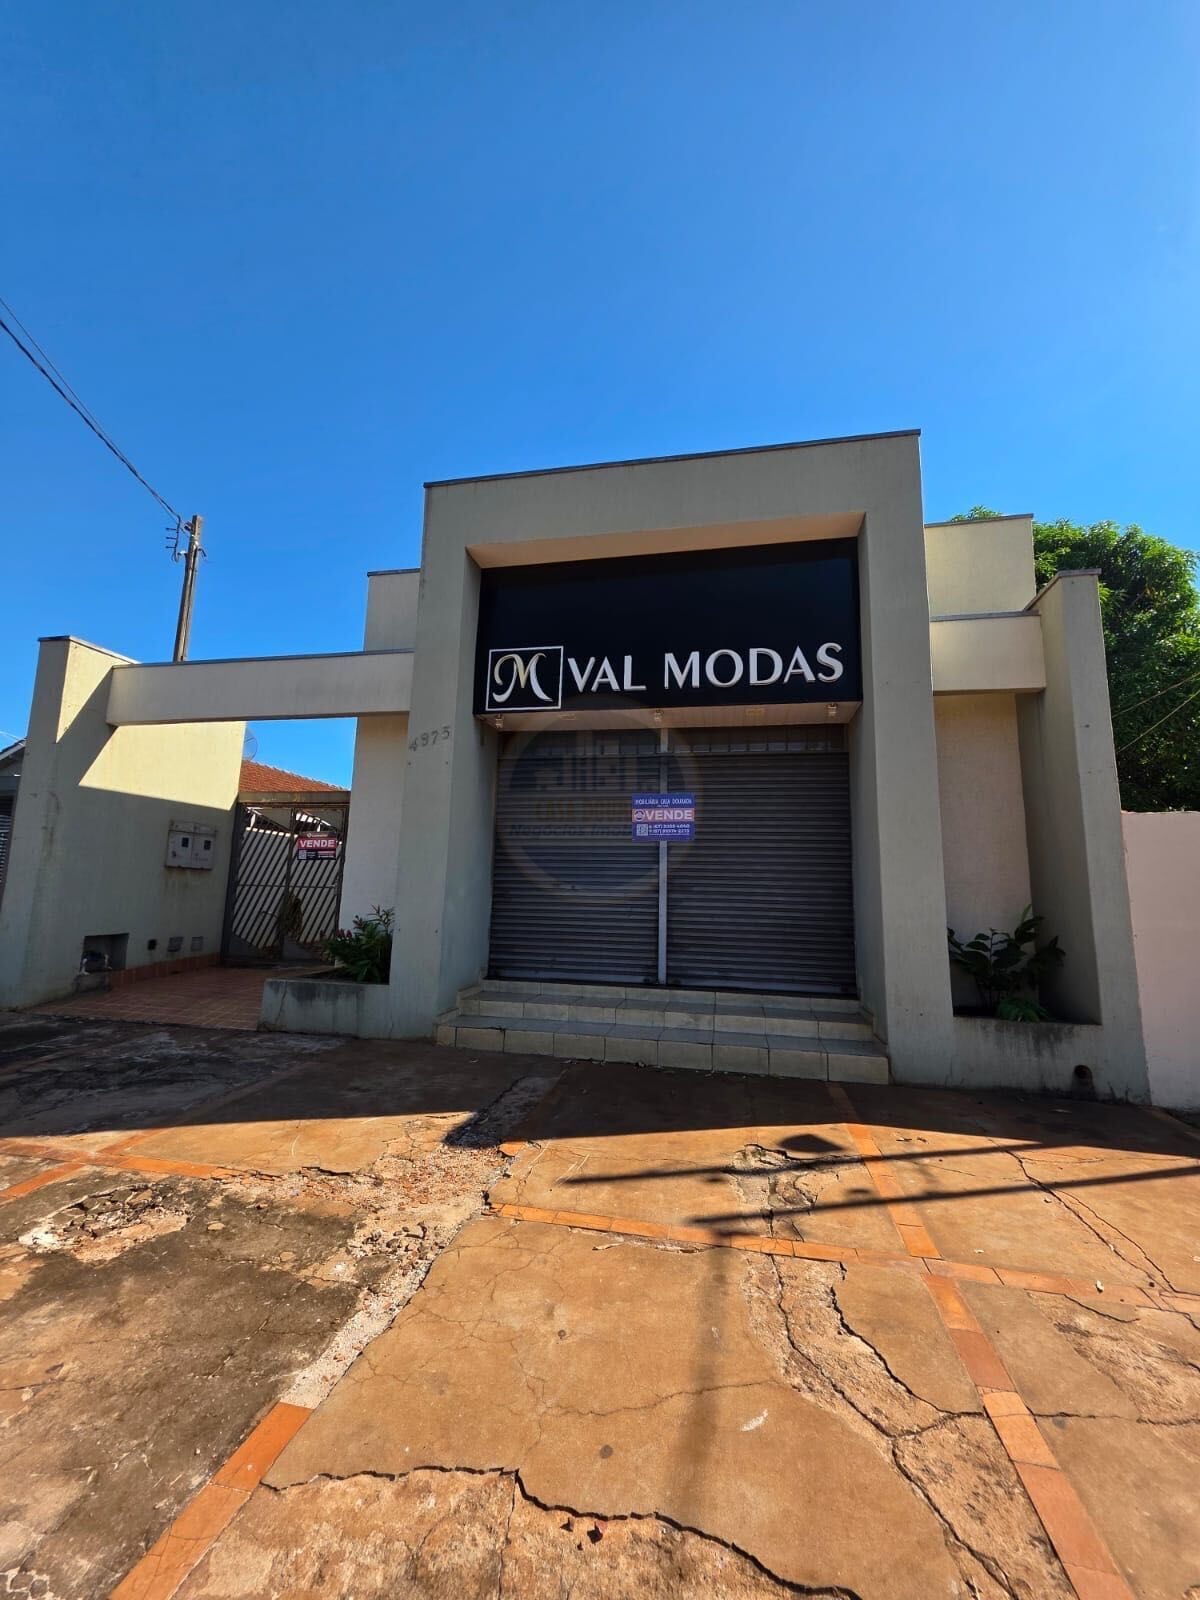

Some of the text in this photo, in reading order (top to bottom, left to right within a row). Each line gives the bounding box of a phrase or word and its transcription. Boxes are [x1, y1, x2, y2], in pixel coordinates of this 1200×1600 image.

[567, 654, 647, 693] VAL
[664, 642, 844, 690] MODAS
[645, 809, 692, 821] VENDE
[300, 839, 335, 848] VENDE
